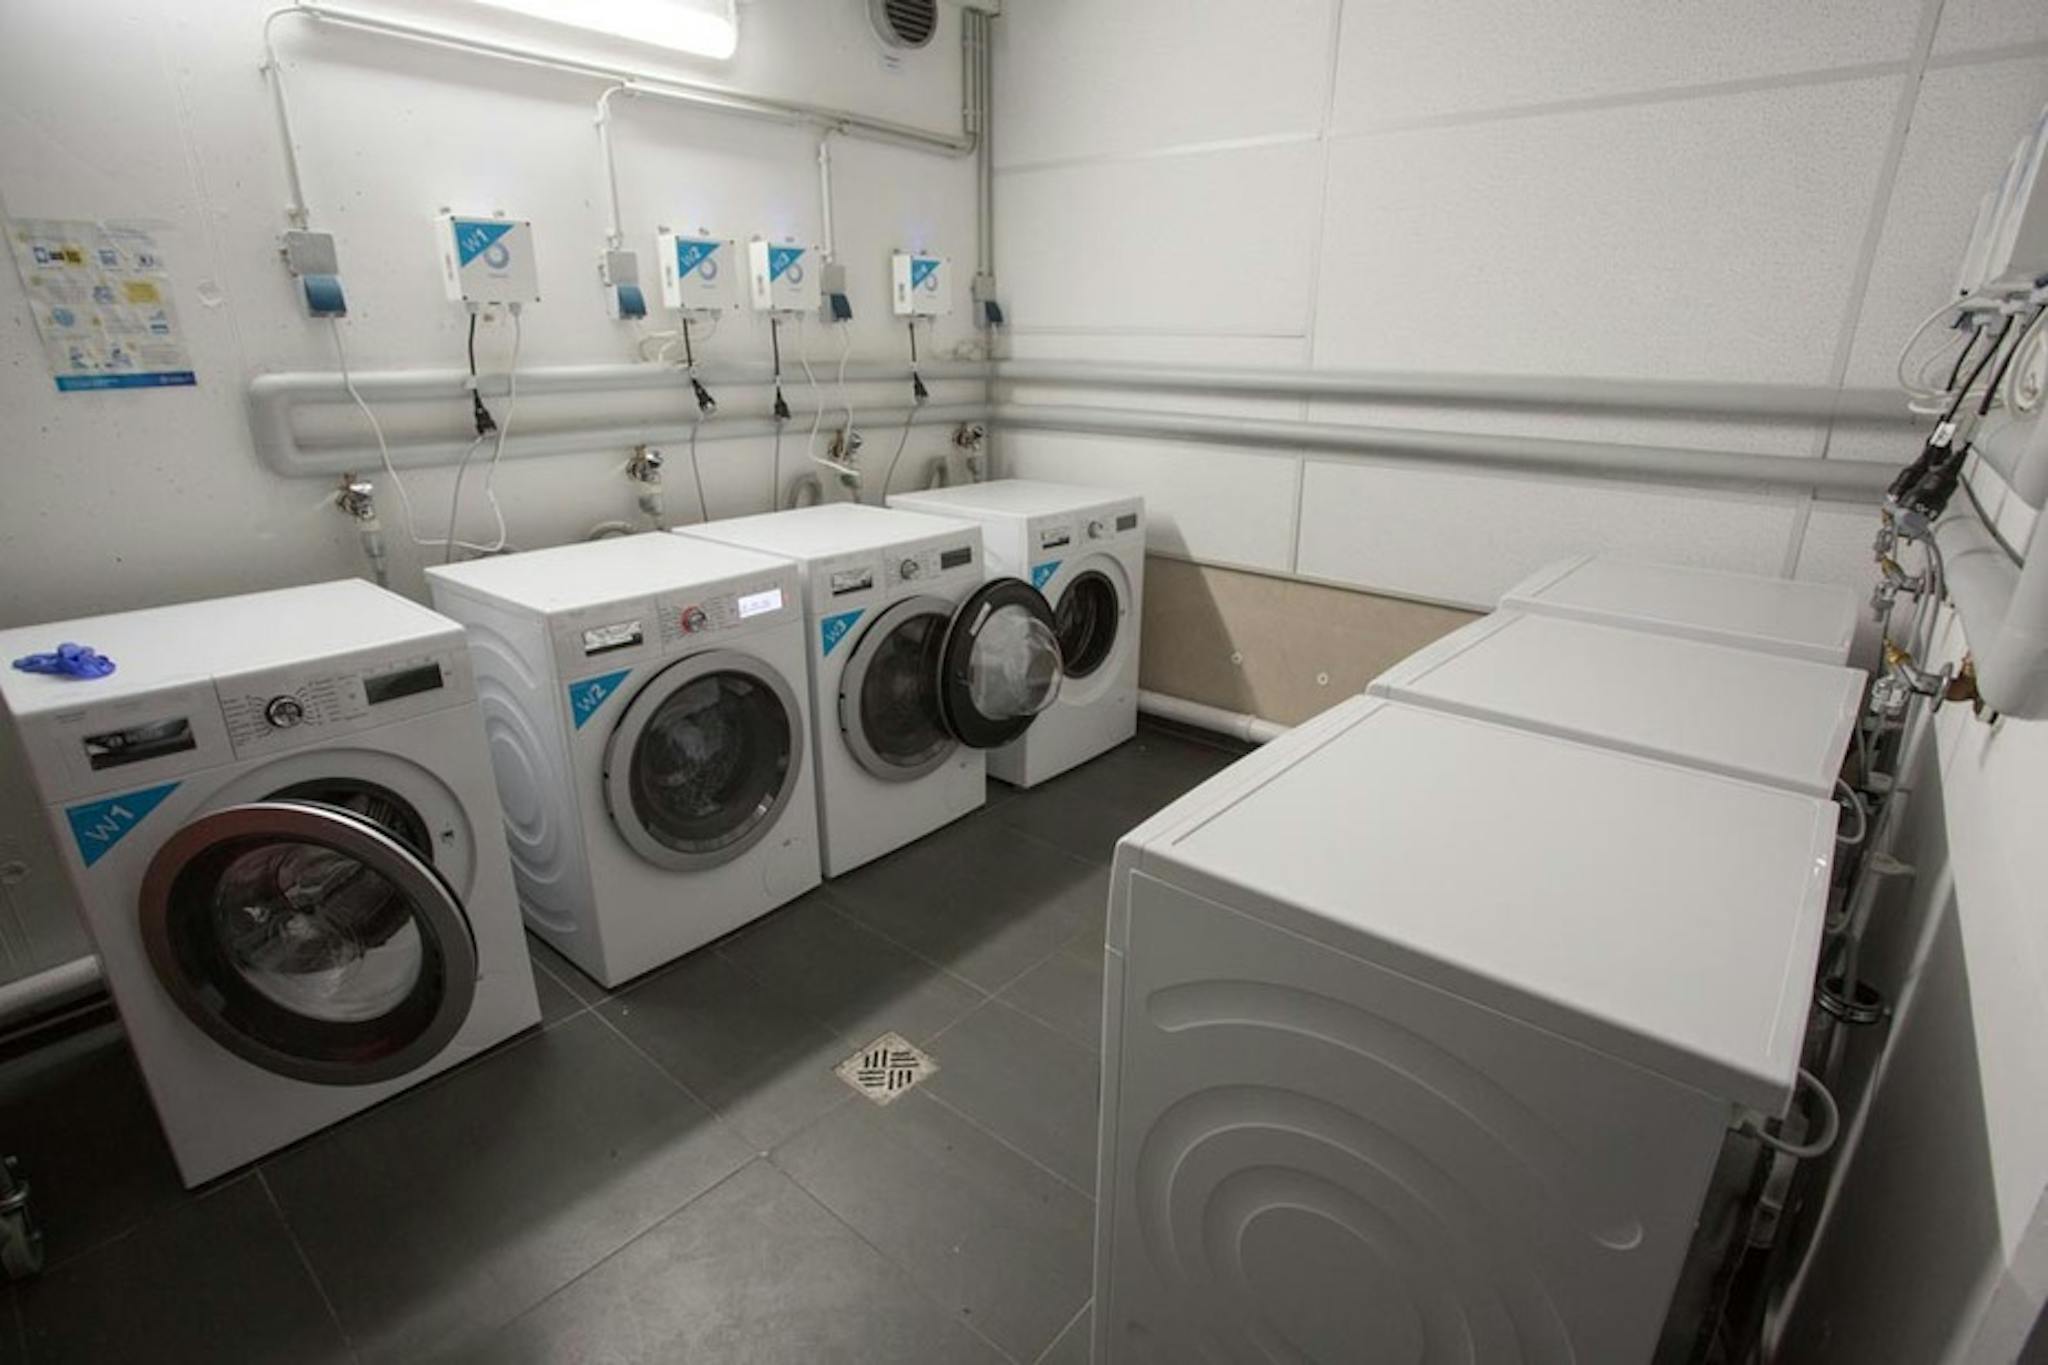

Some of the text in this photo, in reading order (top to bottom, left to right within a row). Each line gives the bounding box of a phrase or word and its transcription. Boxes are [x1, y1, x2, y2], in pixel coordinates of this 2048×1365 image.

[462, 227, 489, 252] W1
[824, 619, 847, 643] W3
[575, 683, 607, 711] W2
[84, 804, 135, 841] W1
